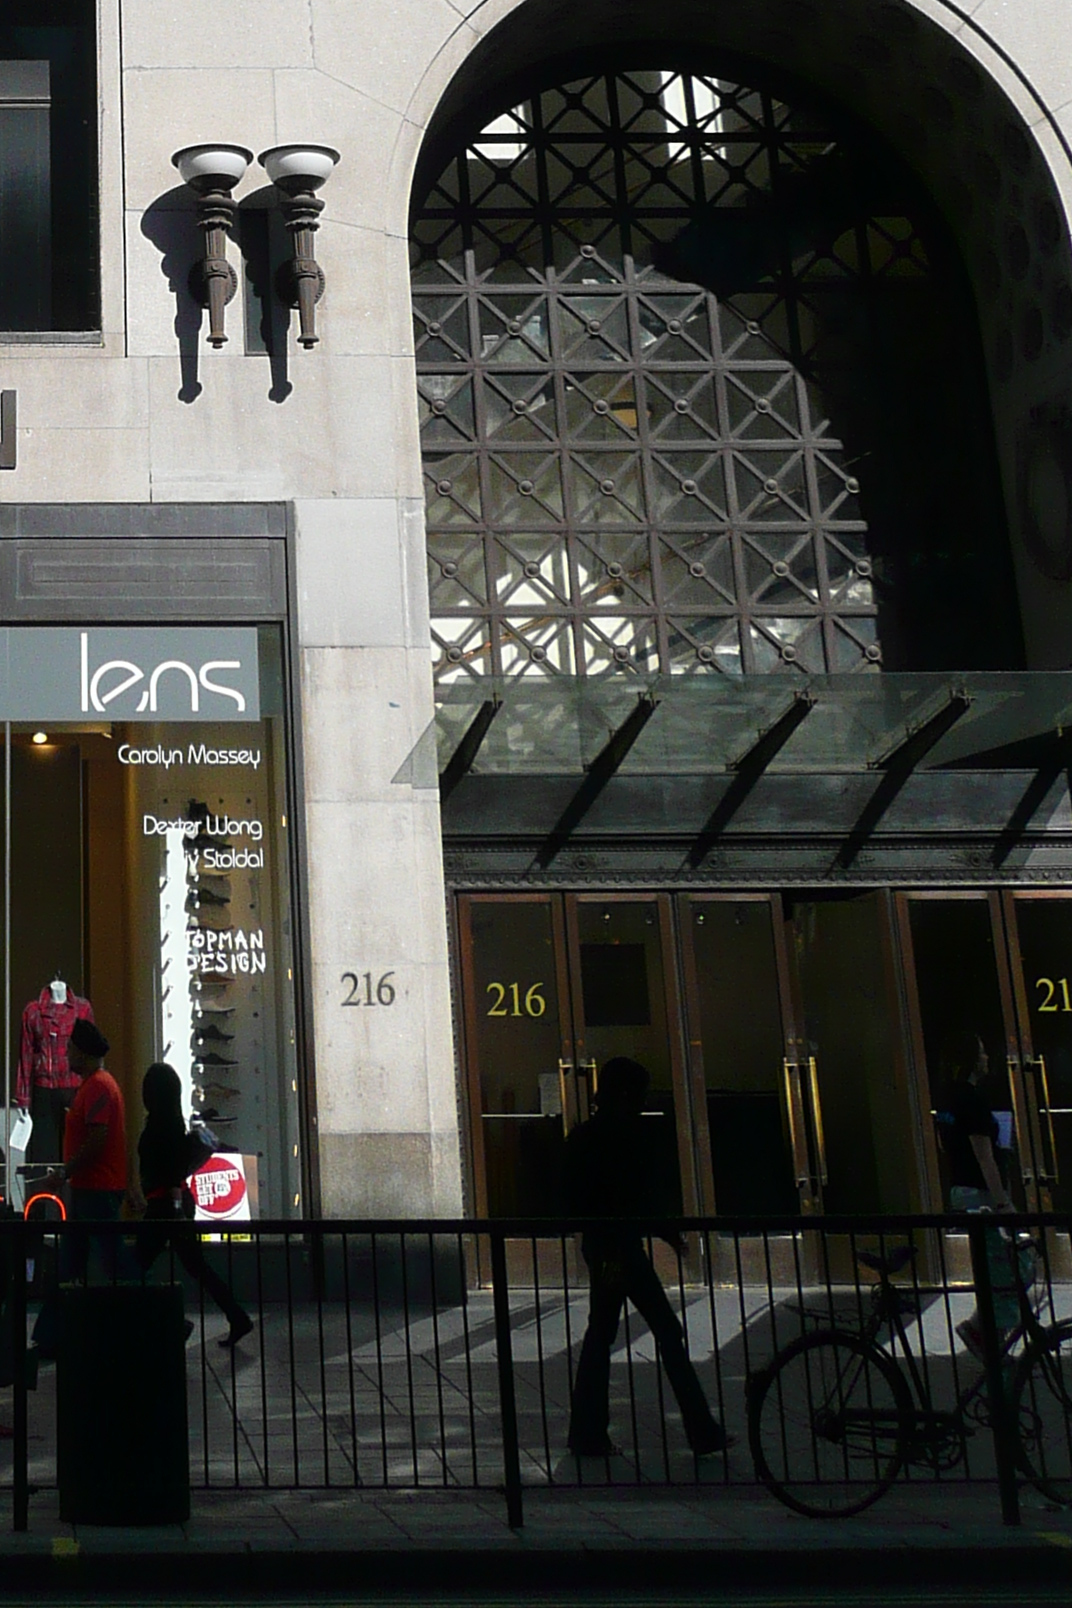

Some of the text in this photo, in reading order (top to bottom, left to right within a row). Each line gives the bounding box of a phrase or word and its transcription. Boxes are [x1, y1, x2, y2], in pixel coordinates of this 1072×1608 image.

[80, 631, 246, 712] lens
[118, 744, 261, 769] Carolyn Massey
[206, 814, 263, 840] Wong
[203, 847, 264, 868] Stoldal
[184, 928, 264, 951] TOPMAN
[184, 951, 266, 974] DESIGN
[340, 971, 395, 1007] 216
[486, 982, 546, 1017] 216
